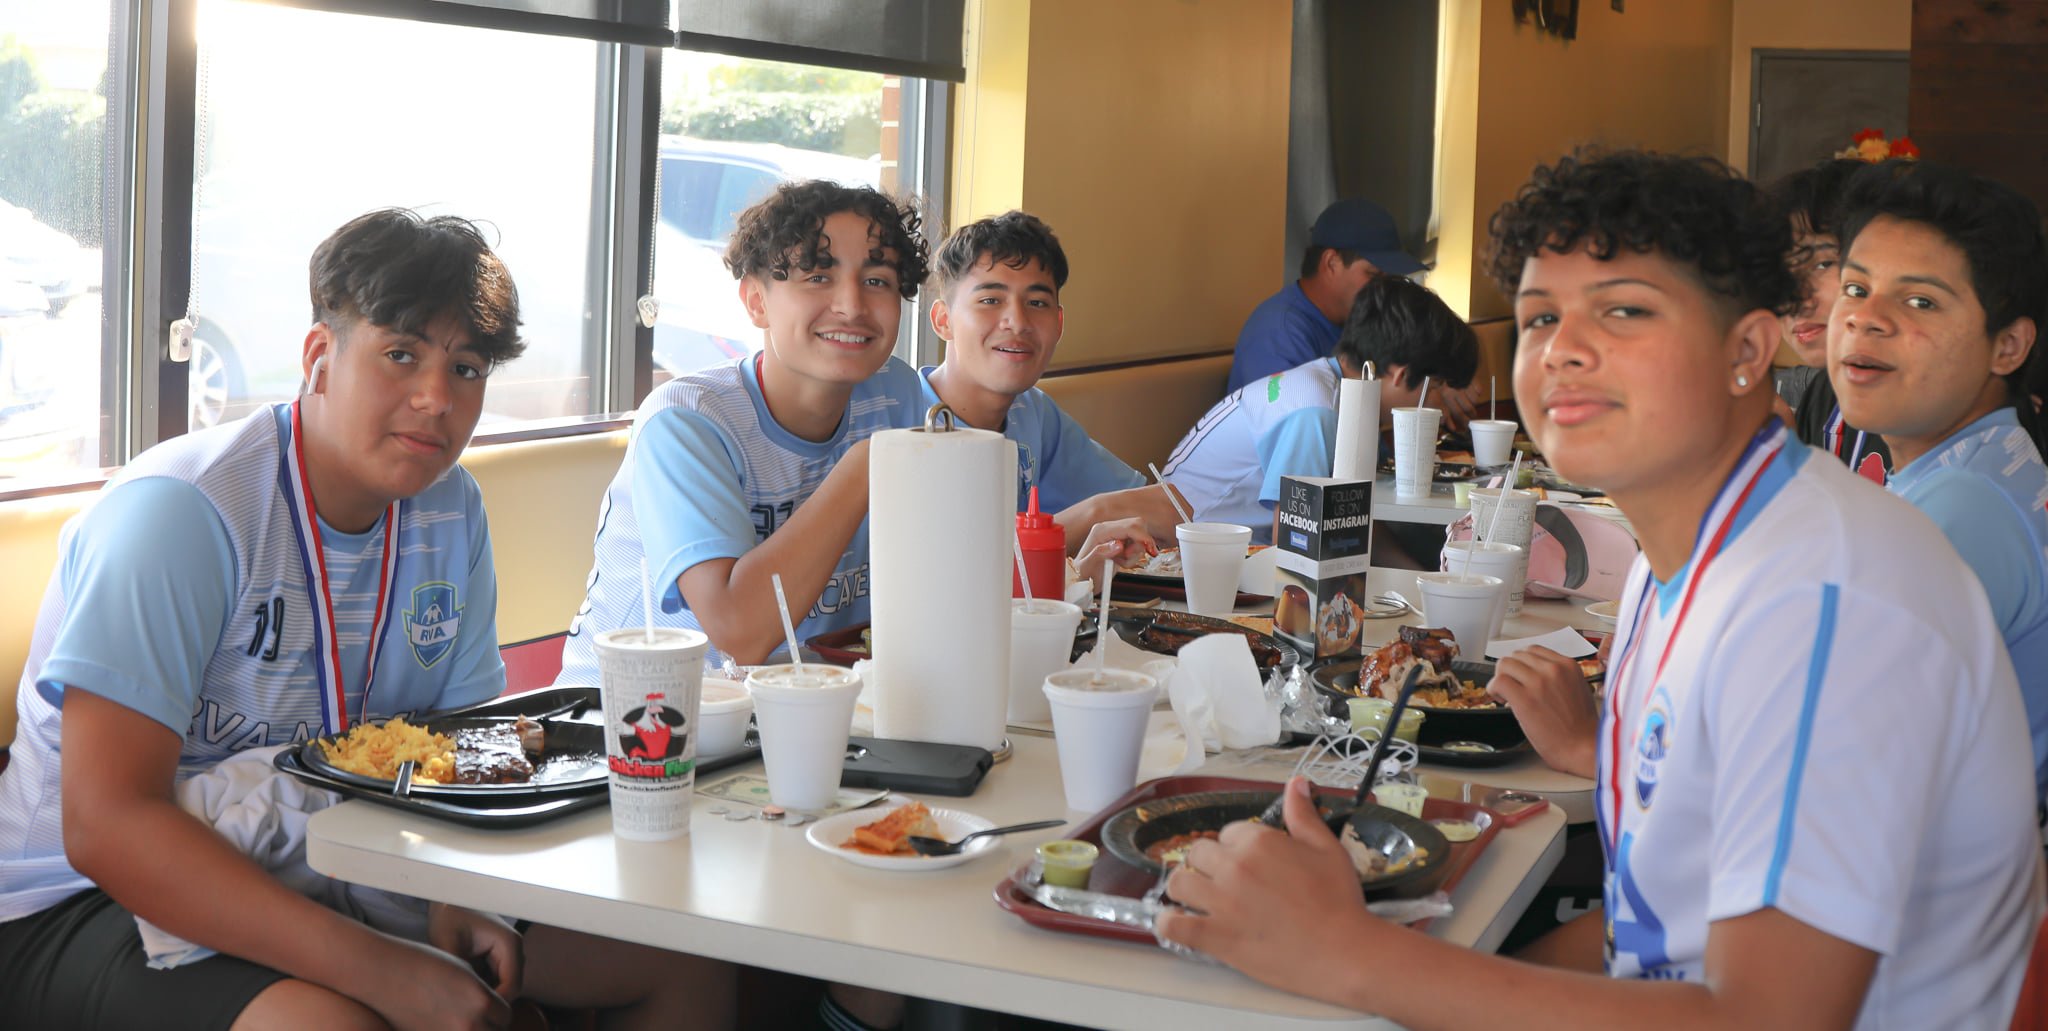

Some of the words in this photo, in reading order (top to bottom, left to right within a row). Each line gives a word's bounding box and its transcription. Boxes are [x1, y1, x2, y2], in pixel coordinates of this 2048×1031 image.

[1291, 486, 1307, 501] LIKE
[1331, 489, 1364, 502] FOLLOW
[1287, 499, 1298, 513] US
[1299, 503, 1311, 517] ON
[1334, 504, 1345, 516] US
[1347, 502, 1361, 515] ON
[1280, 511, 1318, 534] FACEBOOK
[1323, 515, 1369, 531] INSTAGRAM
[420, 625, 446, 642] RVA
